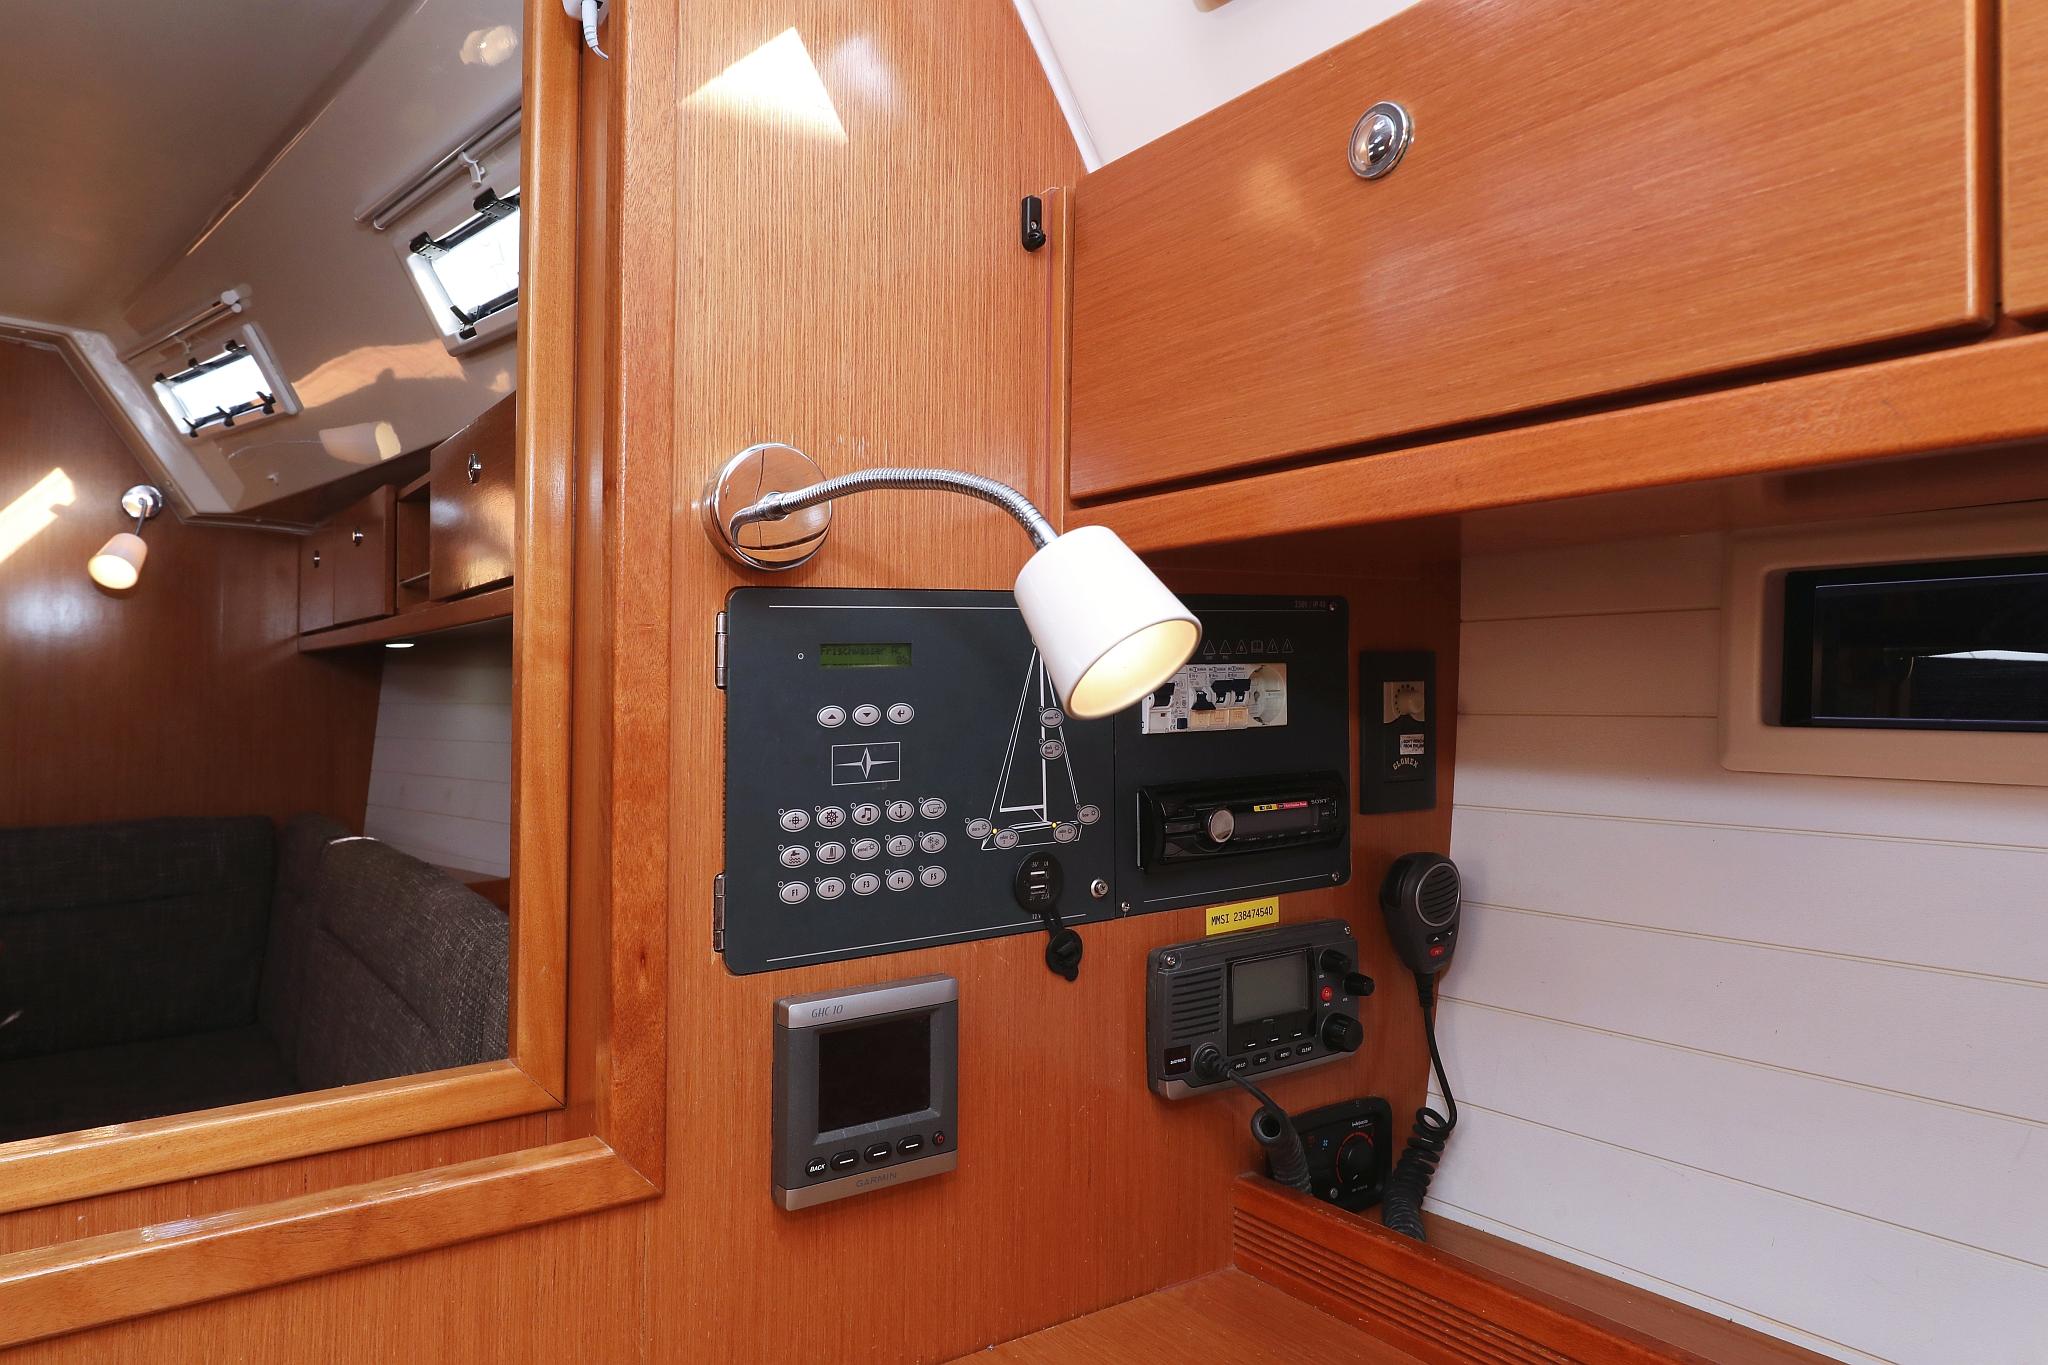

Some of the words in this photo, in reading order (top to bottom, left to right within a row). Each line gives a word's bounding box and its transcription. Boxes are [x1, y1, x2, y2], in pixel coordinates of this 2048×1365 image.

[897, 876, 904, 885] F4
[930, 872, 937, 880] F5
[827, 884, 835, 893] F2
[863, 880, 870, 888] F3
[791, 888, 799, 897] F1
[1211, 912, 1230, 926] MMSI
[1233, 905, 1274, 922] 238474540
[811, 1006, 830, 1019] GHC
[833, 1004, 844, 1015] 10
[809, 1162, 827, 1173] BACK
[855, 1172, 897, 1188] GARMIN
